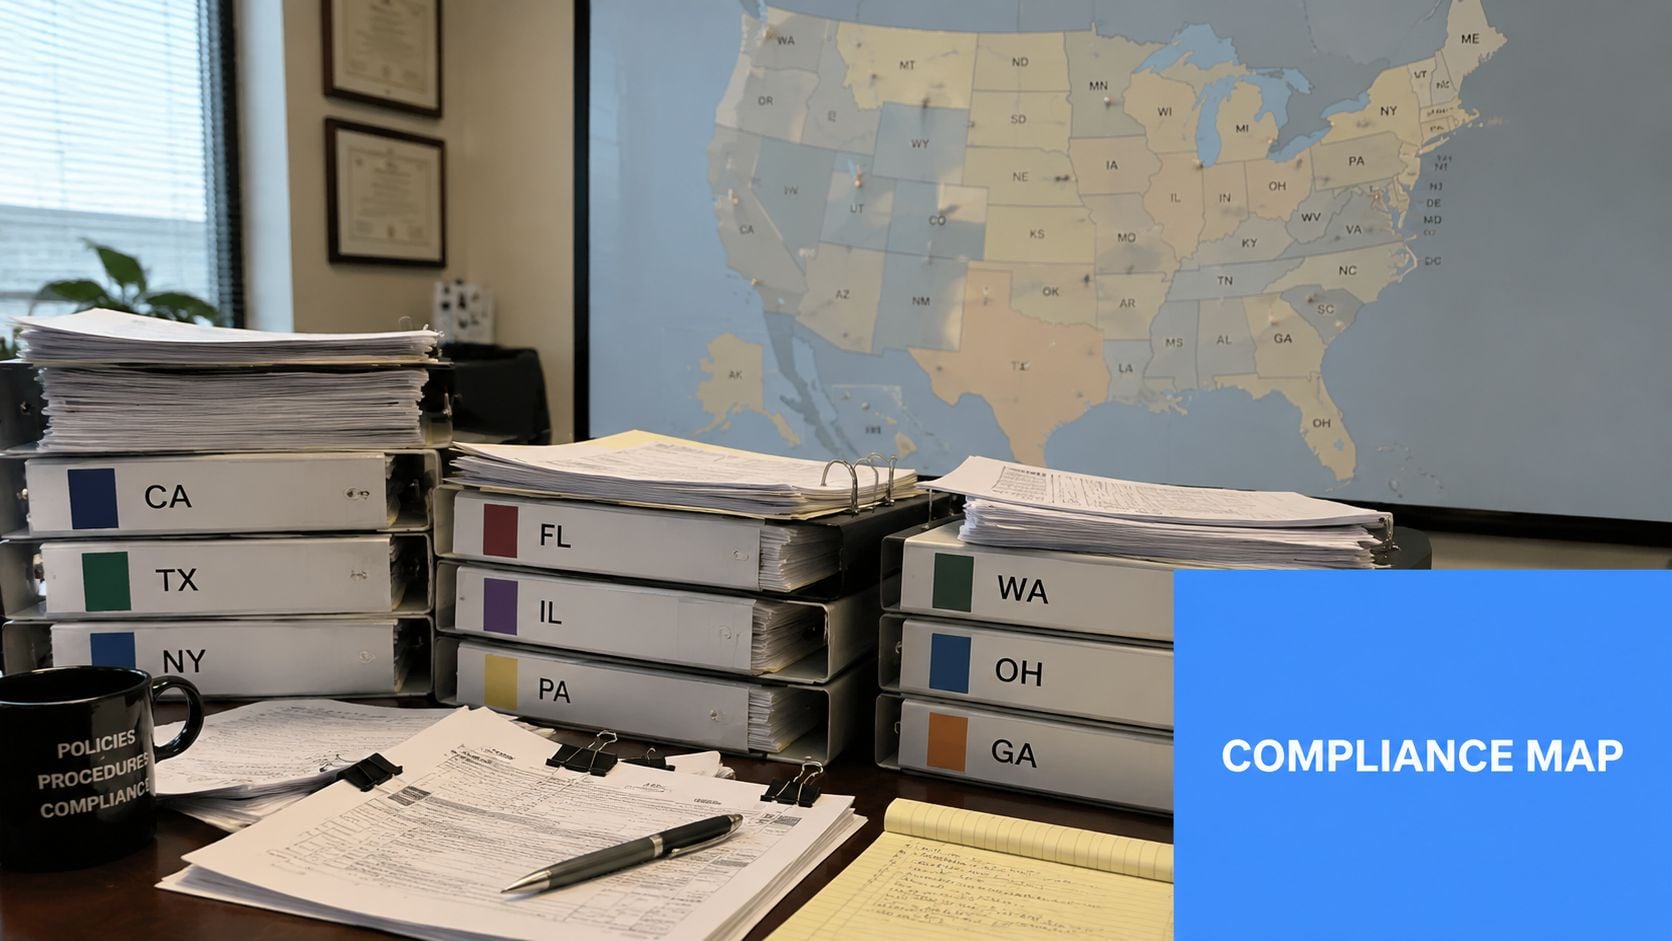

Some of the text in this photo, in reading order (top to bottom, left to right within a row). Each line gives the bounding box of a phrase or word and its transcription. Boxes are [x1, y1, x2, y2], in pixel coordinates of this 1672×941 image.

[777, 36, 795, 46] WA
[1461, 33, 1480, 44] ME
[900, 61, 915, 70] MT
[1012, 57, 1029, 67] ND
[1089, 81, 1109, 91] MN
[1158, 107, 1172, 117] WI
[1380, 106, 1397, 116] NY
[1011, 115, 1027, 124] SD
[1236, 124, 1249, 134] MI
[911, 138, 930, 149] WY
[1106, 161, 1118, 170] IA
[1348, 156, 1365, 166] PA
[1013, 172, 1029, 182] NE
[1268, 181, 1287, 191] OH
[1171, 194, 1181, 203] IL
[1219, 193, 1231, 203] IN
[850, 203, 863, 213] UT
[1426, 199, 1441, 208] DE
[929, 215, 946, 226] CO
[1301, 212, 1321, 222] WV
[1424, 215, 1442, 224] MD
[739, 225, 755, 235] CA
[1030, 229, 1045, 239] KS
[1346, 225, 1362, 235] VA
[1242, 238, 1257, 248] KY
[1338, 265, 1357, 276] NC
[1217, 276, 1233, 286] TN
[836, 290, 850, 299] AZ
[1042, 286, 1059, 297] OK
[912, 296, 930, 306] NM
[1119, 298, 1135, 308] AR
[1317, 304, 1334, 315] SC
[1165, 338, 1183, 348] MS
[1217, 335, 1232, 345] AL
[1274, 333, 1292, 344] GA
[1118, 363, 1133, 373] LA
[1312, 418, 1331, 428] OH
[144, 485, 192, 508] CA
[540, 524, 572, 548] FL
[155, 568, 199, 591] TX
[998, 575, 1049, 604] WA
[540, 600, 562, 625] IL
[163, 649, 206, 673] NY
[995, 658, 1043, 687] OH
[539, 678, 571, 703] PA
[57, 730, 136, 759] POLICIES
[991, 739, 1037, 768] GA
[37, 751, 149, 790] PROCEDURES
[40, 777, 151, 818] COMPLIANCE
